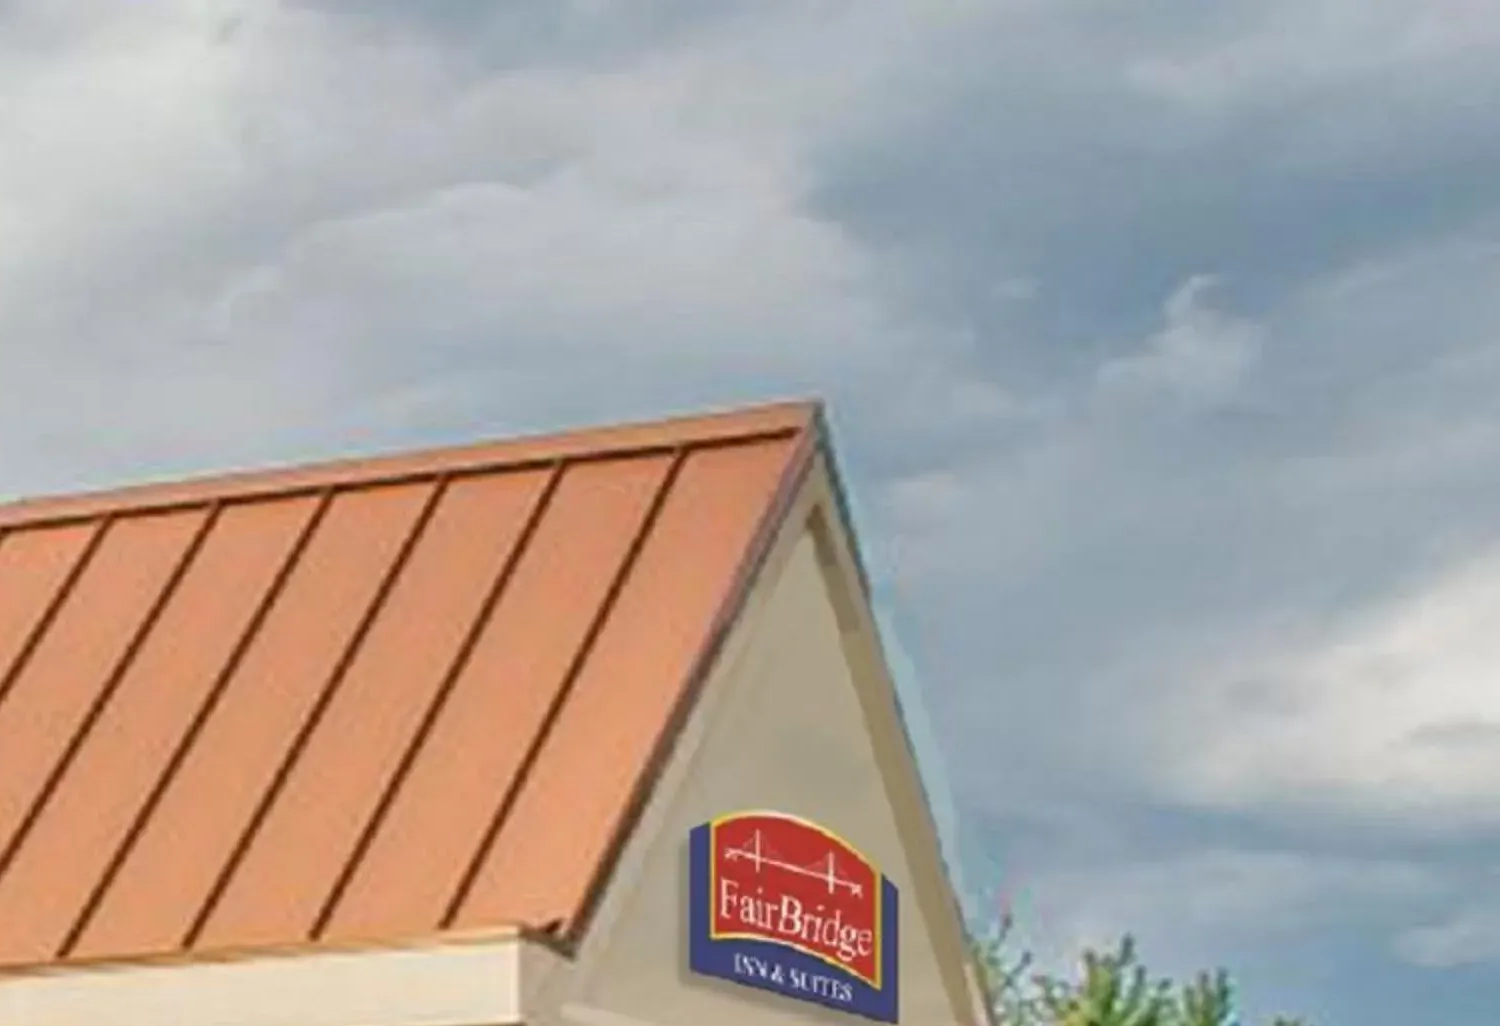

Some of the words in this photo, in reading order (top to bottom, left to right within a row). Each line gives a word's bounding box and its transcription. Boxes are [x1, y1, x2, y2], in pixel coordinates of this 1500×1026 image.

[720, 876, 873, 963] FairBridge
[733, 953, 767, 980] INN
[771, 964, 784, 985] &
[790, 968, 853, 1001] SUITES
